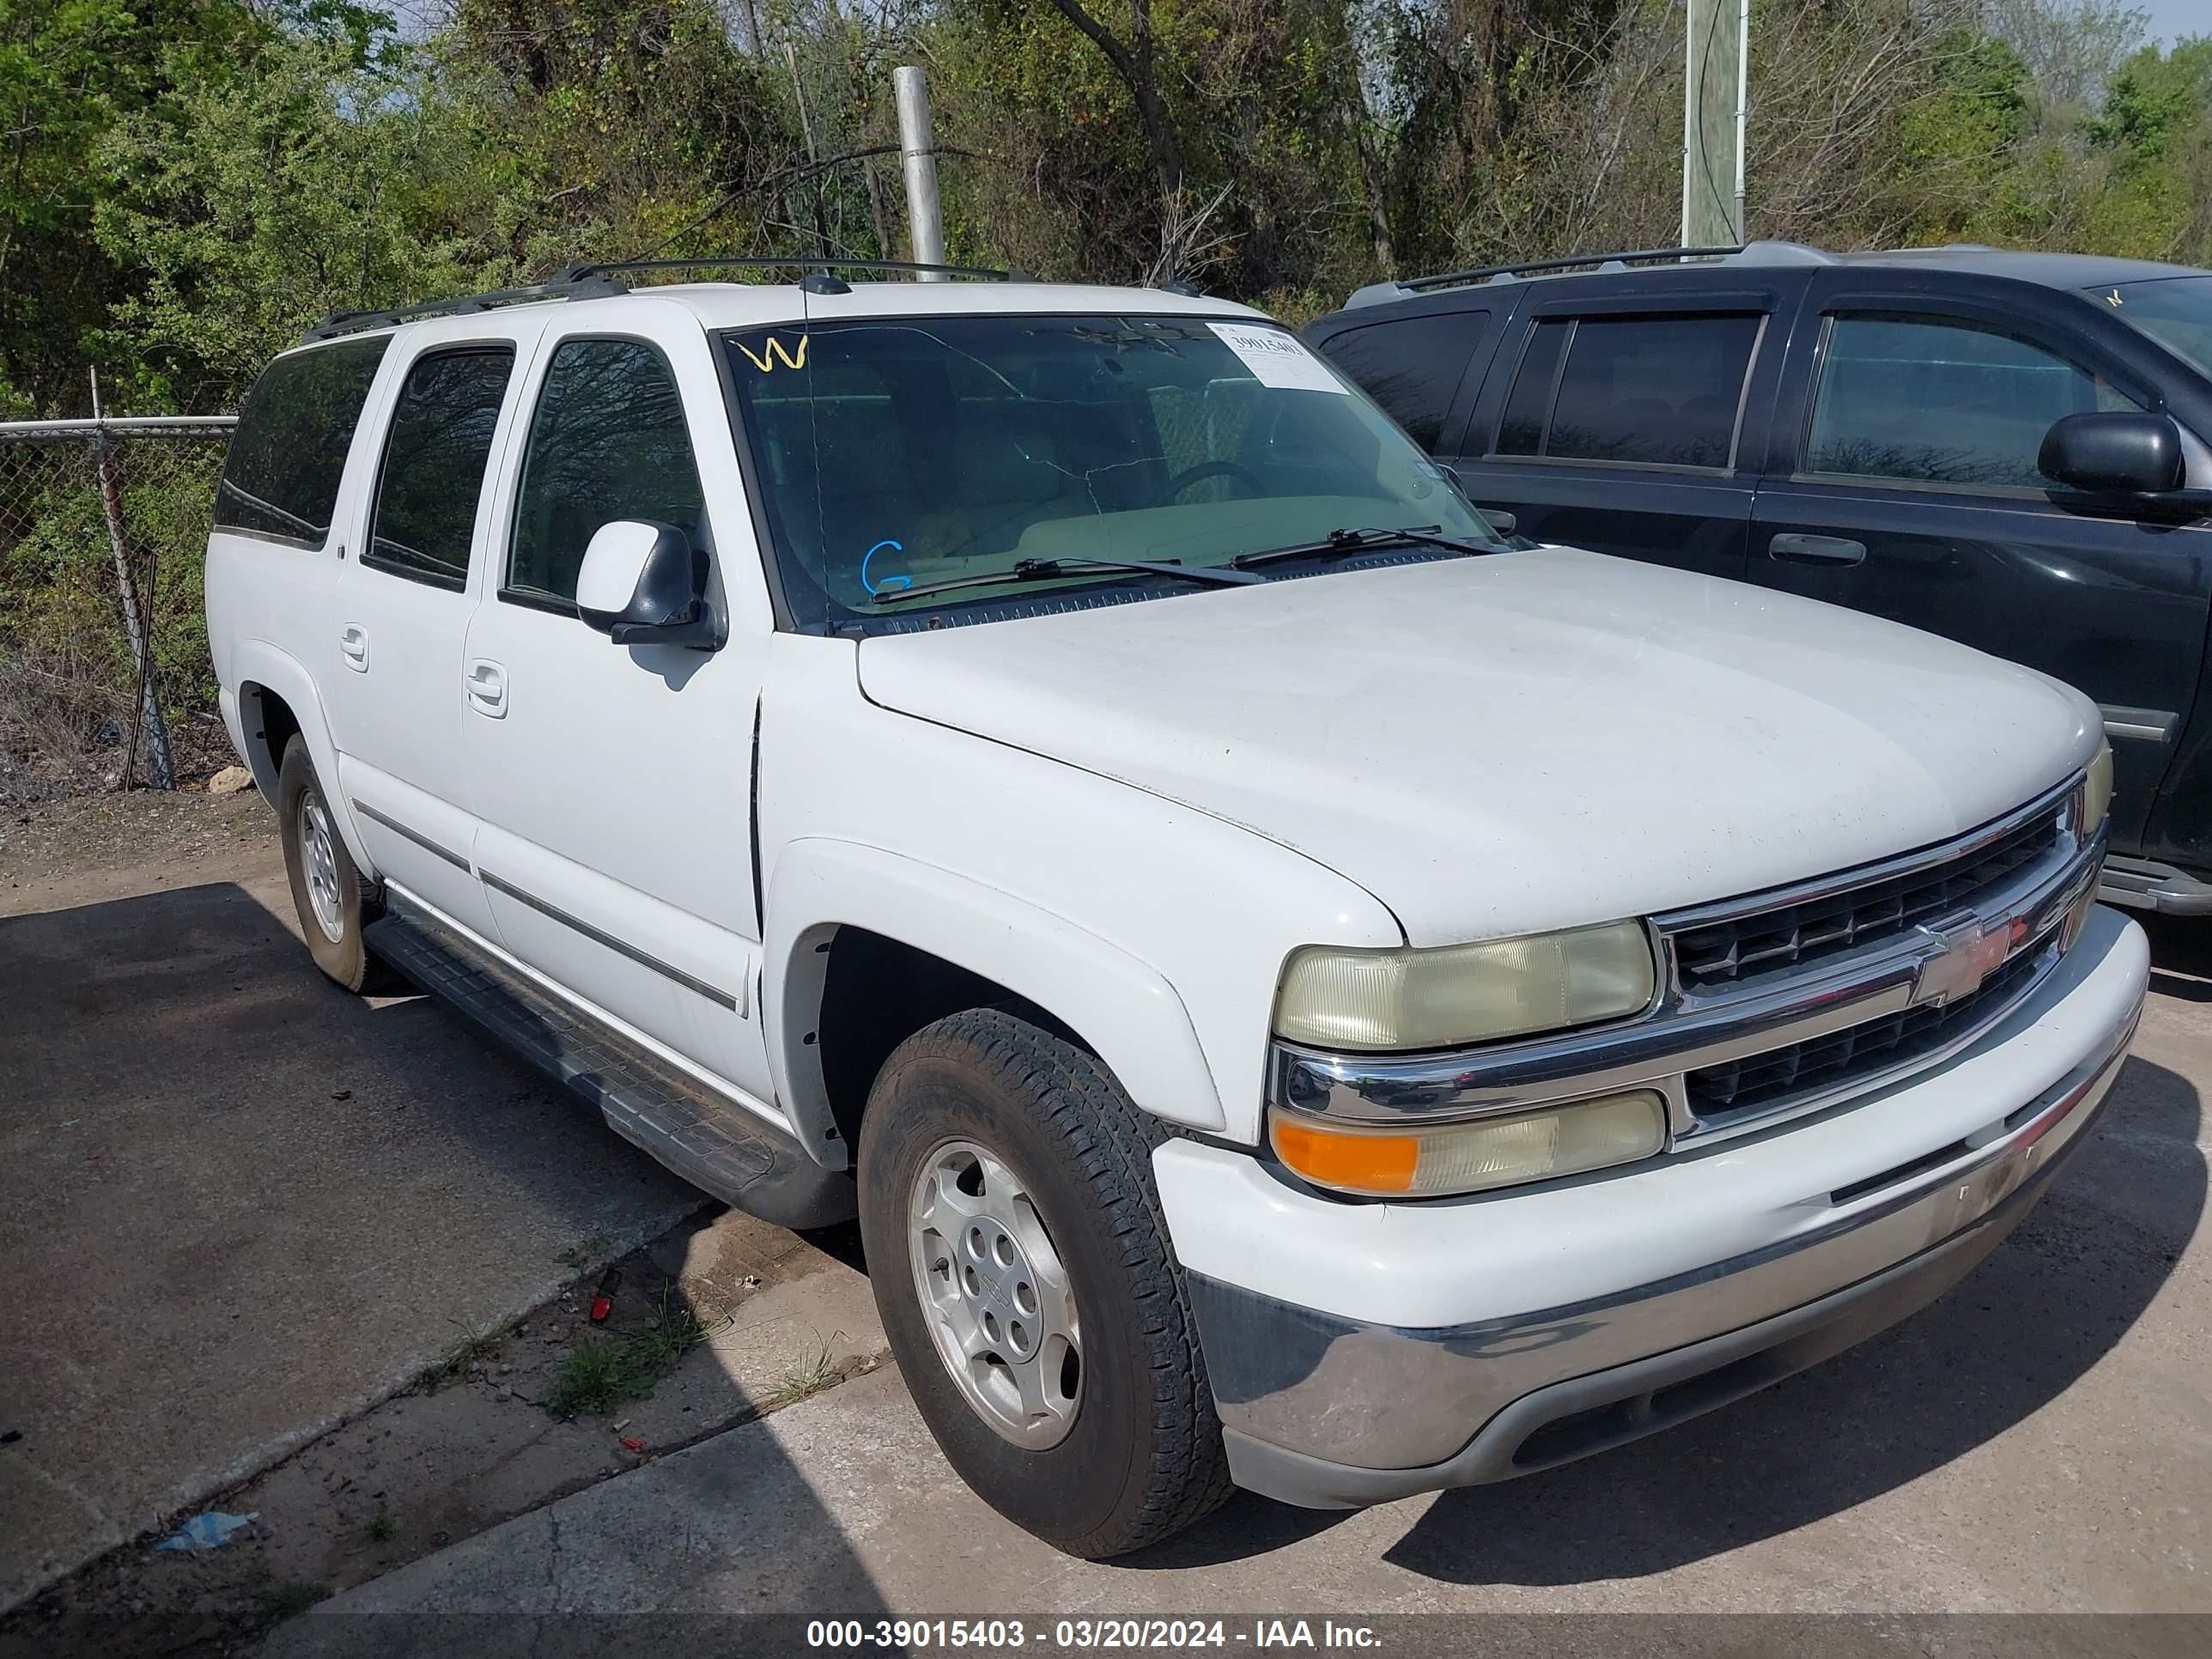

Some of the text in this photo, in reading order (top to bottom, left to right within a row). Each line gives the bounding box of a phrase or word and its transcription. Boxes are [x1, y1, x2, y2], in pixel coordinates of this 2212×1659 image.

[727, 334, 808, 372] W
[1231, 336, 1304, 356] 39015403
[862, 540, 911, 594] G
